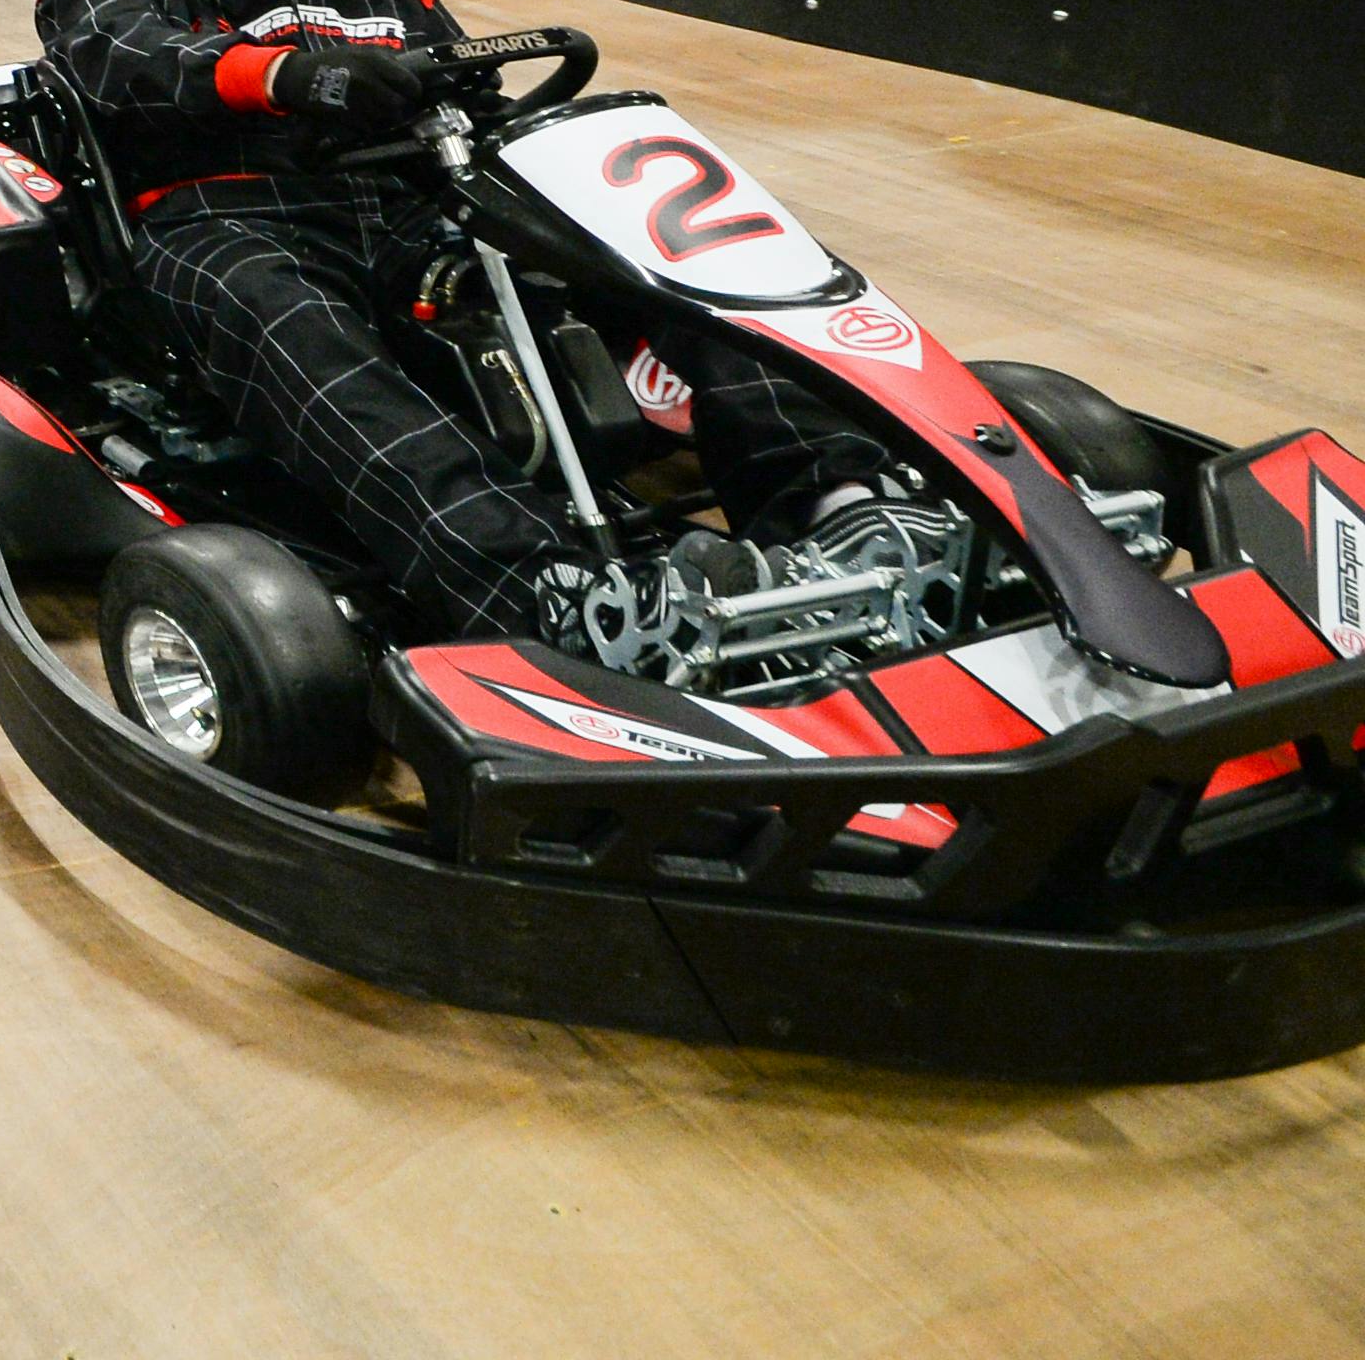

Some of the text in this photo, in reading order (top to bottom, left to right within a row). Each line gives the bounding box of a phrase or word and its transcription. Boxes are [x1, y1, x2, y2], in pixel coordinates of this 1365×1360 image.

[452, 32, 549, 59] BIZKARTS
[602, 135, 785, 263] 2
[1335, 519, 1364, 629] TeamSport
